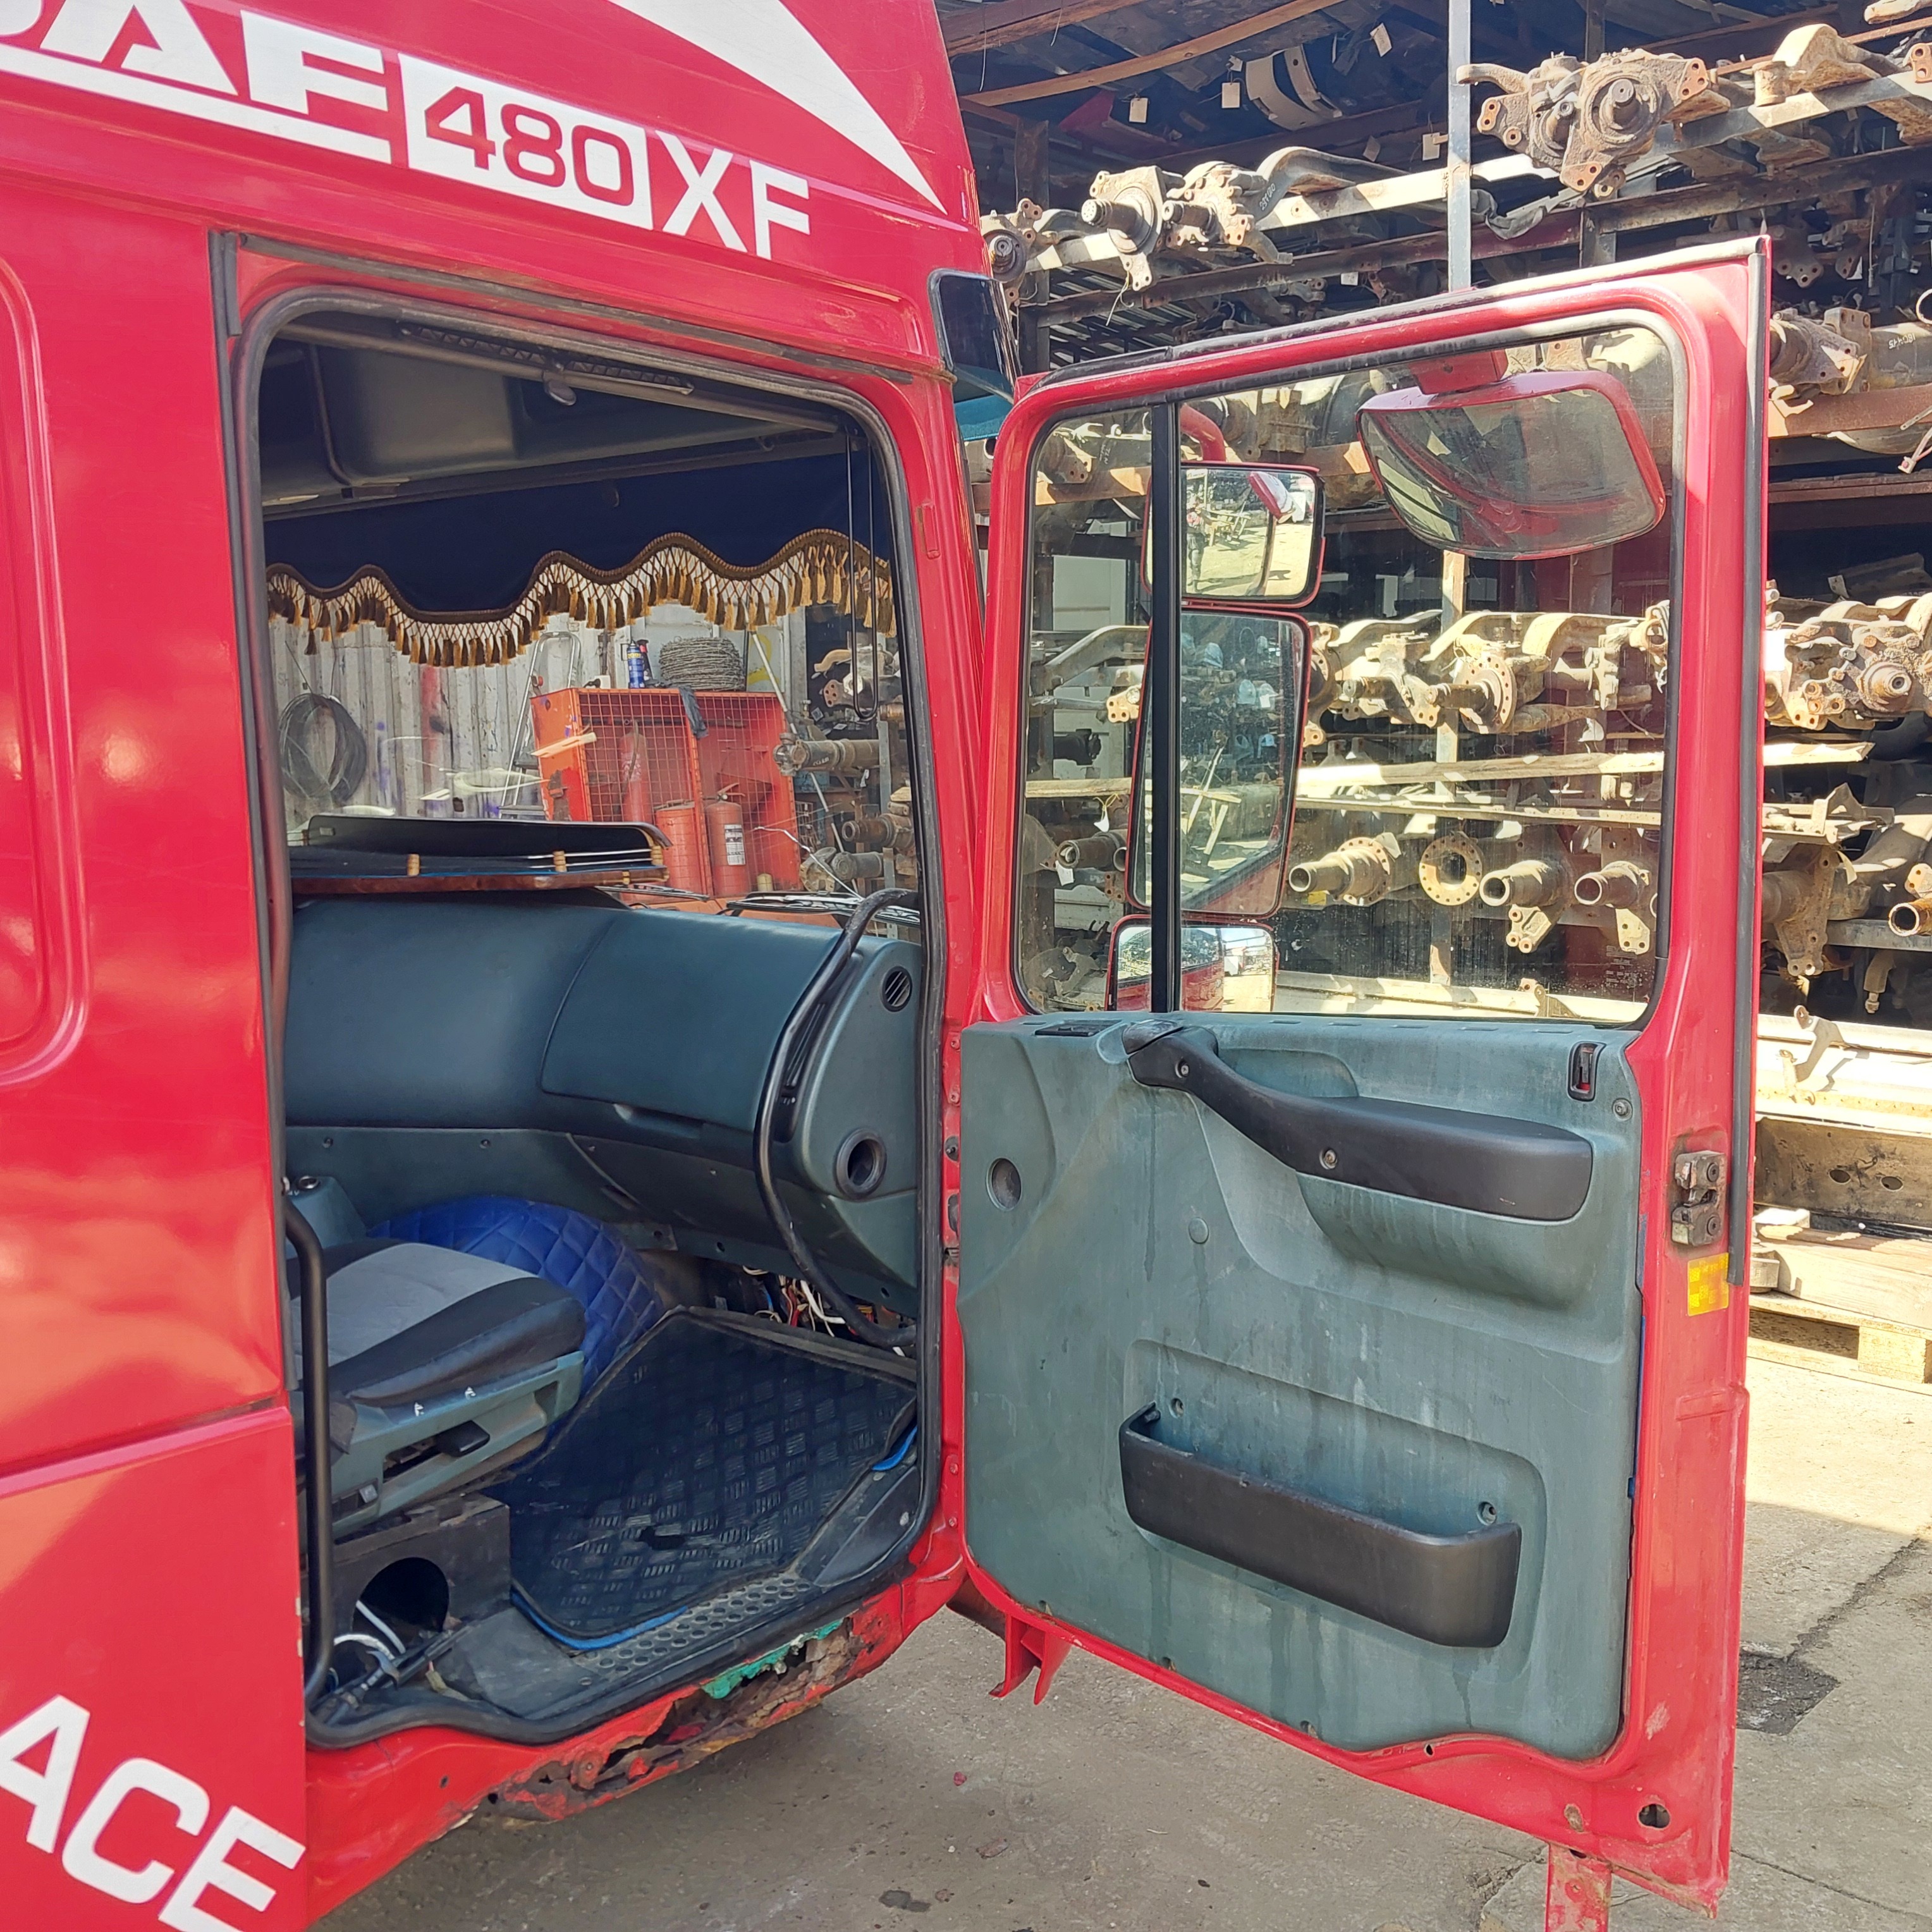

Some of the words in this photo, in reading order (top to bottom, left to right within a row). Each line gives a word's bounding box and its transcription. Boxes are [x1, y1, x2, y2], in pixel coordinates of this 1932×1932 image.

[0, 0, 388, 115] AF
[424, 86, 634, 207] 480
[655, 130, 810, 260] XF
[0, 1694, 306, 1932] ACE
